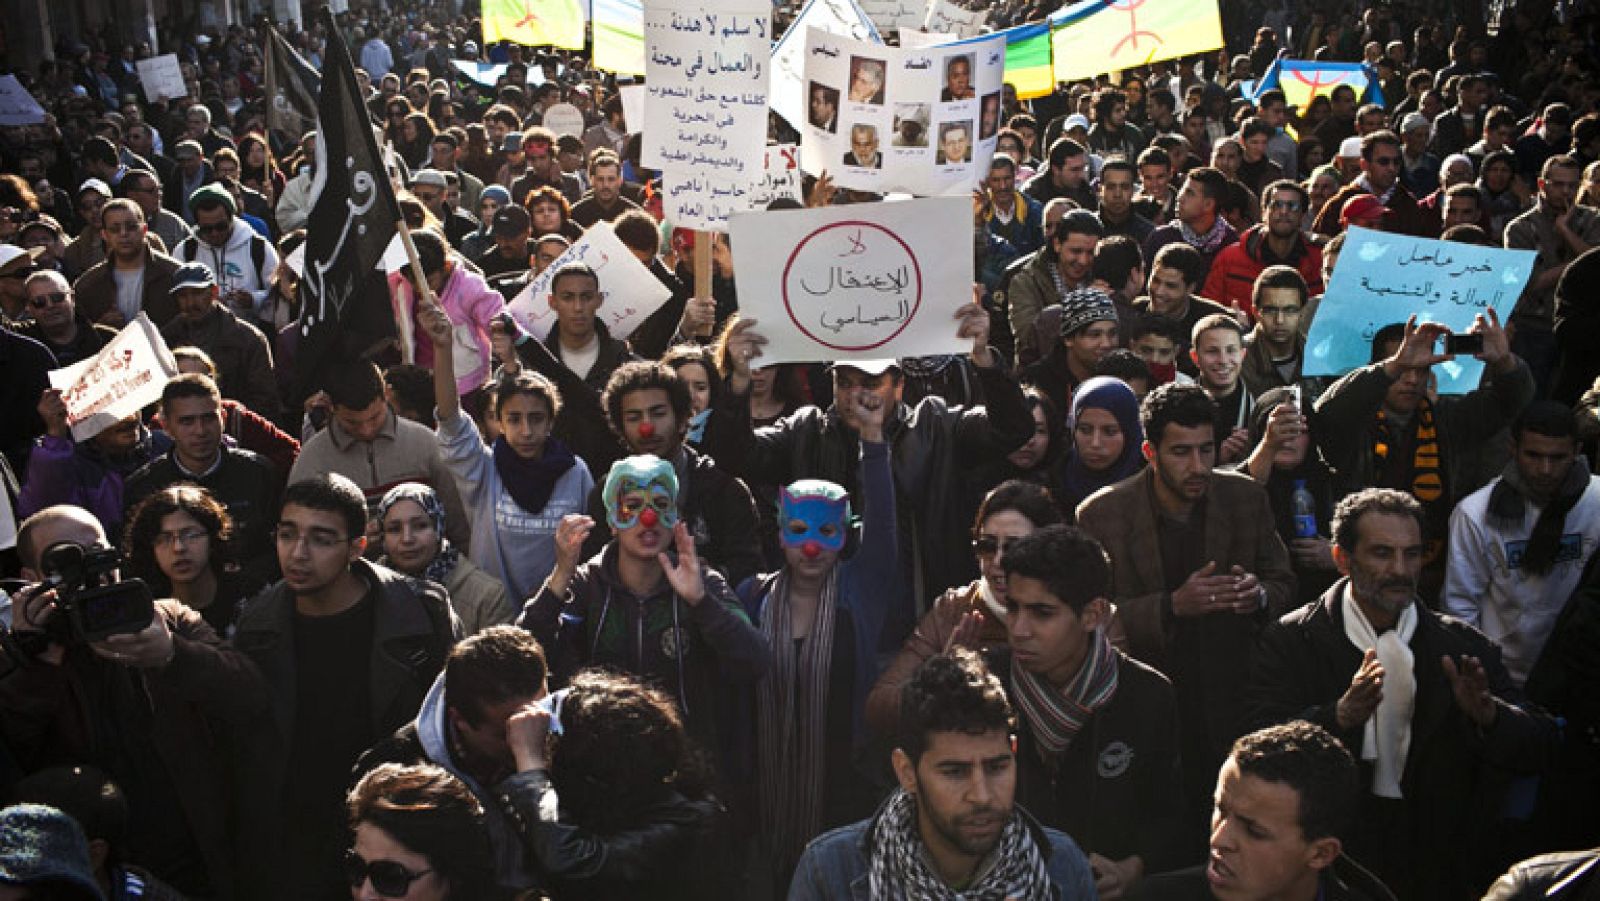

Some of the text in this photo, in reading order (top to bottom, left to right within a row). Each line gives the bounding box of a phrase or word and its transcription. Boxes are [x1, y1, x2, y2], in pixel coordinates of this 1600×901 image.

[705, 14, 717, 36] لا
[753, 17, 767, 38] لا
[651, 45, 761, 81] والعمال في محنة
[718, 95, 738, 109] مع
[716, 112, 734, 128] في
[678, 129, 728, 151] والكرامة
[838, 228, 867, 257] لا
[1396, 243, 1454, 266] عاجل
[820, 299, 909, 333] السياسي
